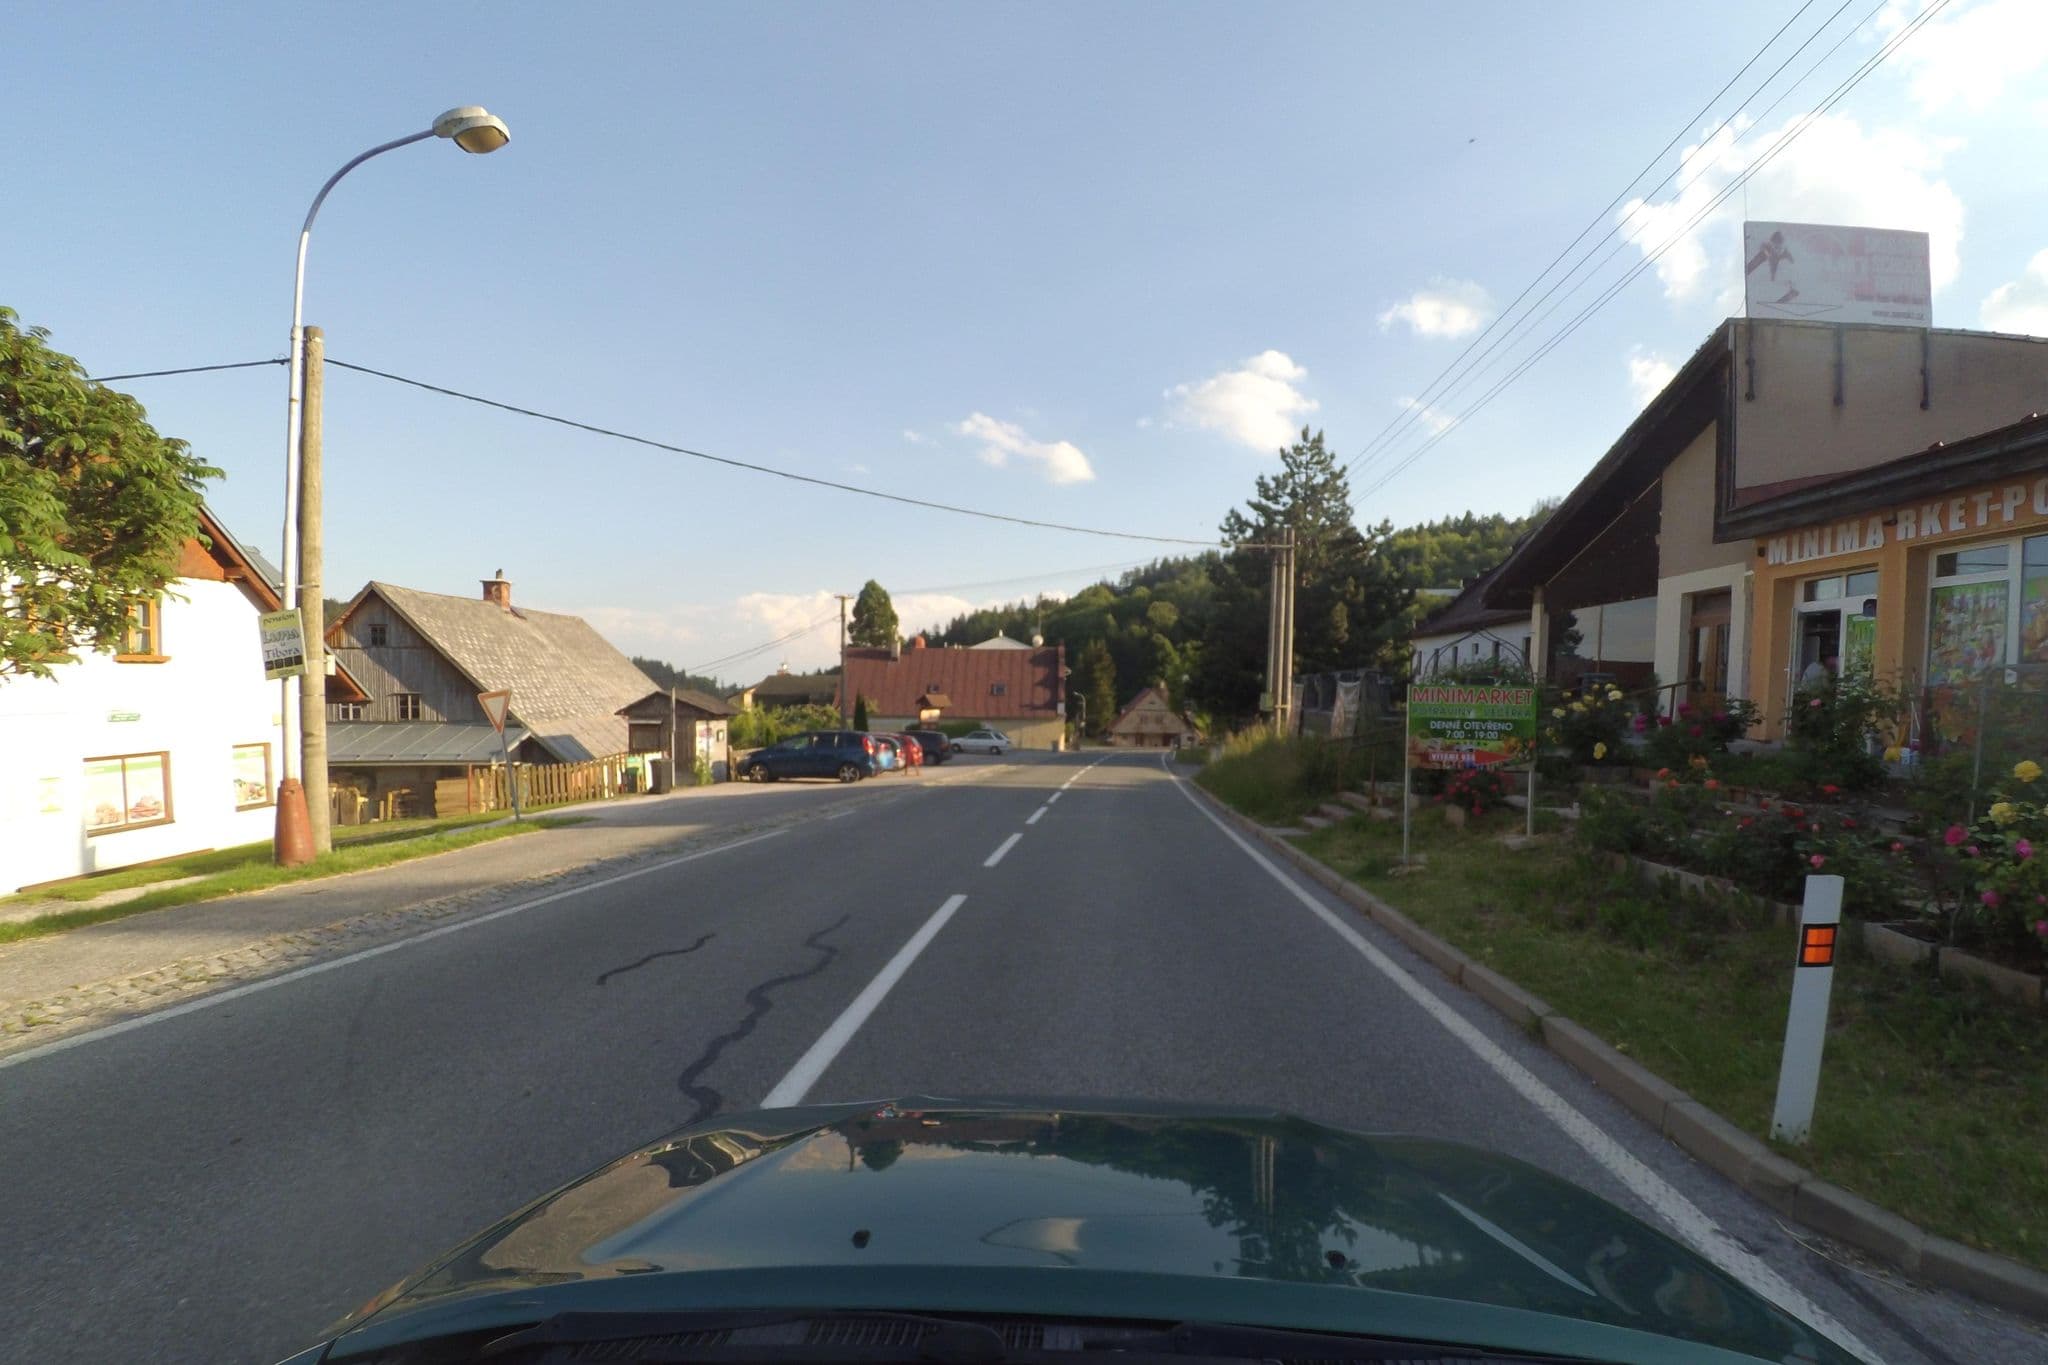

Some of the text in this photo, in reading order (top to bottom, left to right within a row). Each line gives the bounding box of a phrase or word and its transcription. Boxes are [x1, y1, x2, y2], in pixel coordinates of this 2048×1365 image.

[1412, 687, 1534, 705] MINIMARKET
[1463, 720, 1513, 731] OTEVŘENO
[1446, 731, 1465, 739] 7:00
[1474, 731, 1499, 739] 19:00
